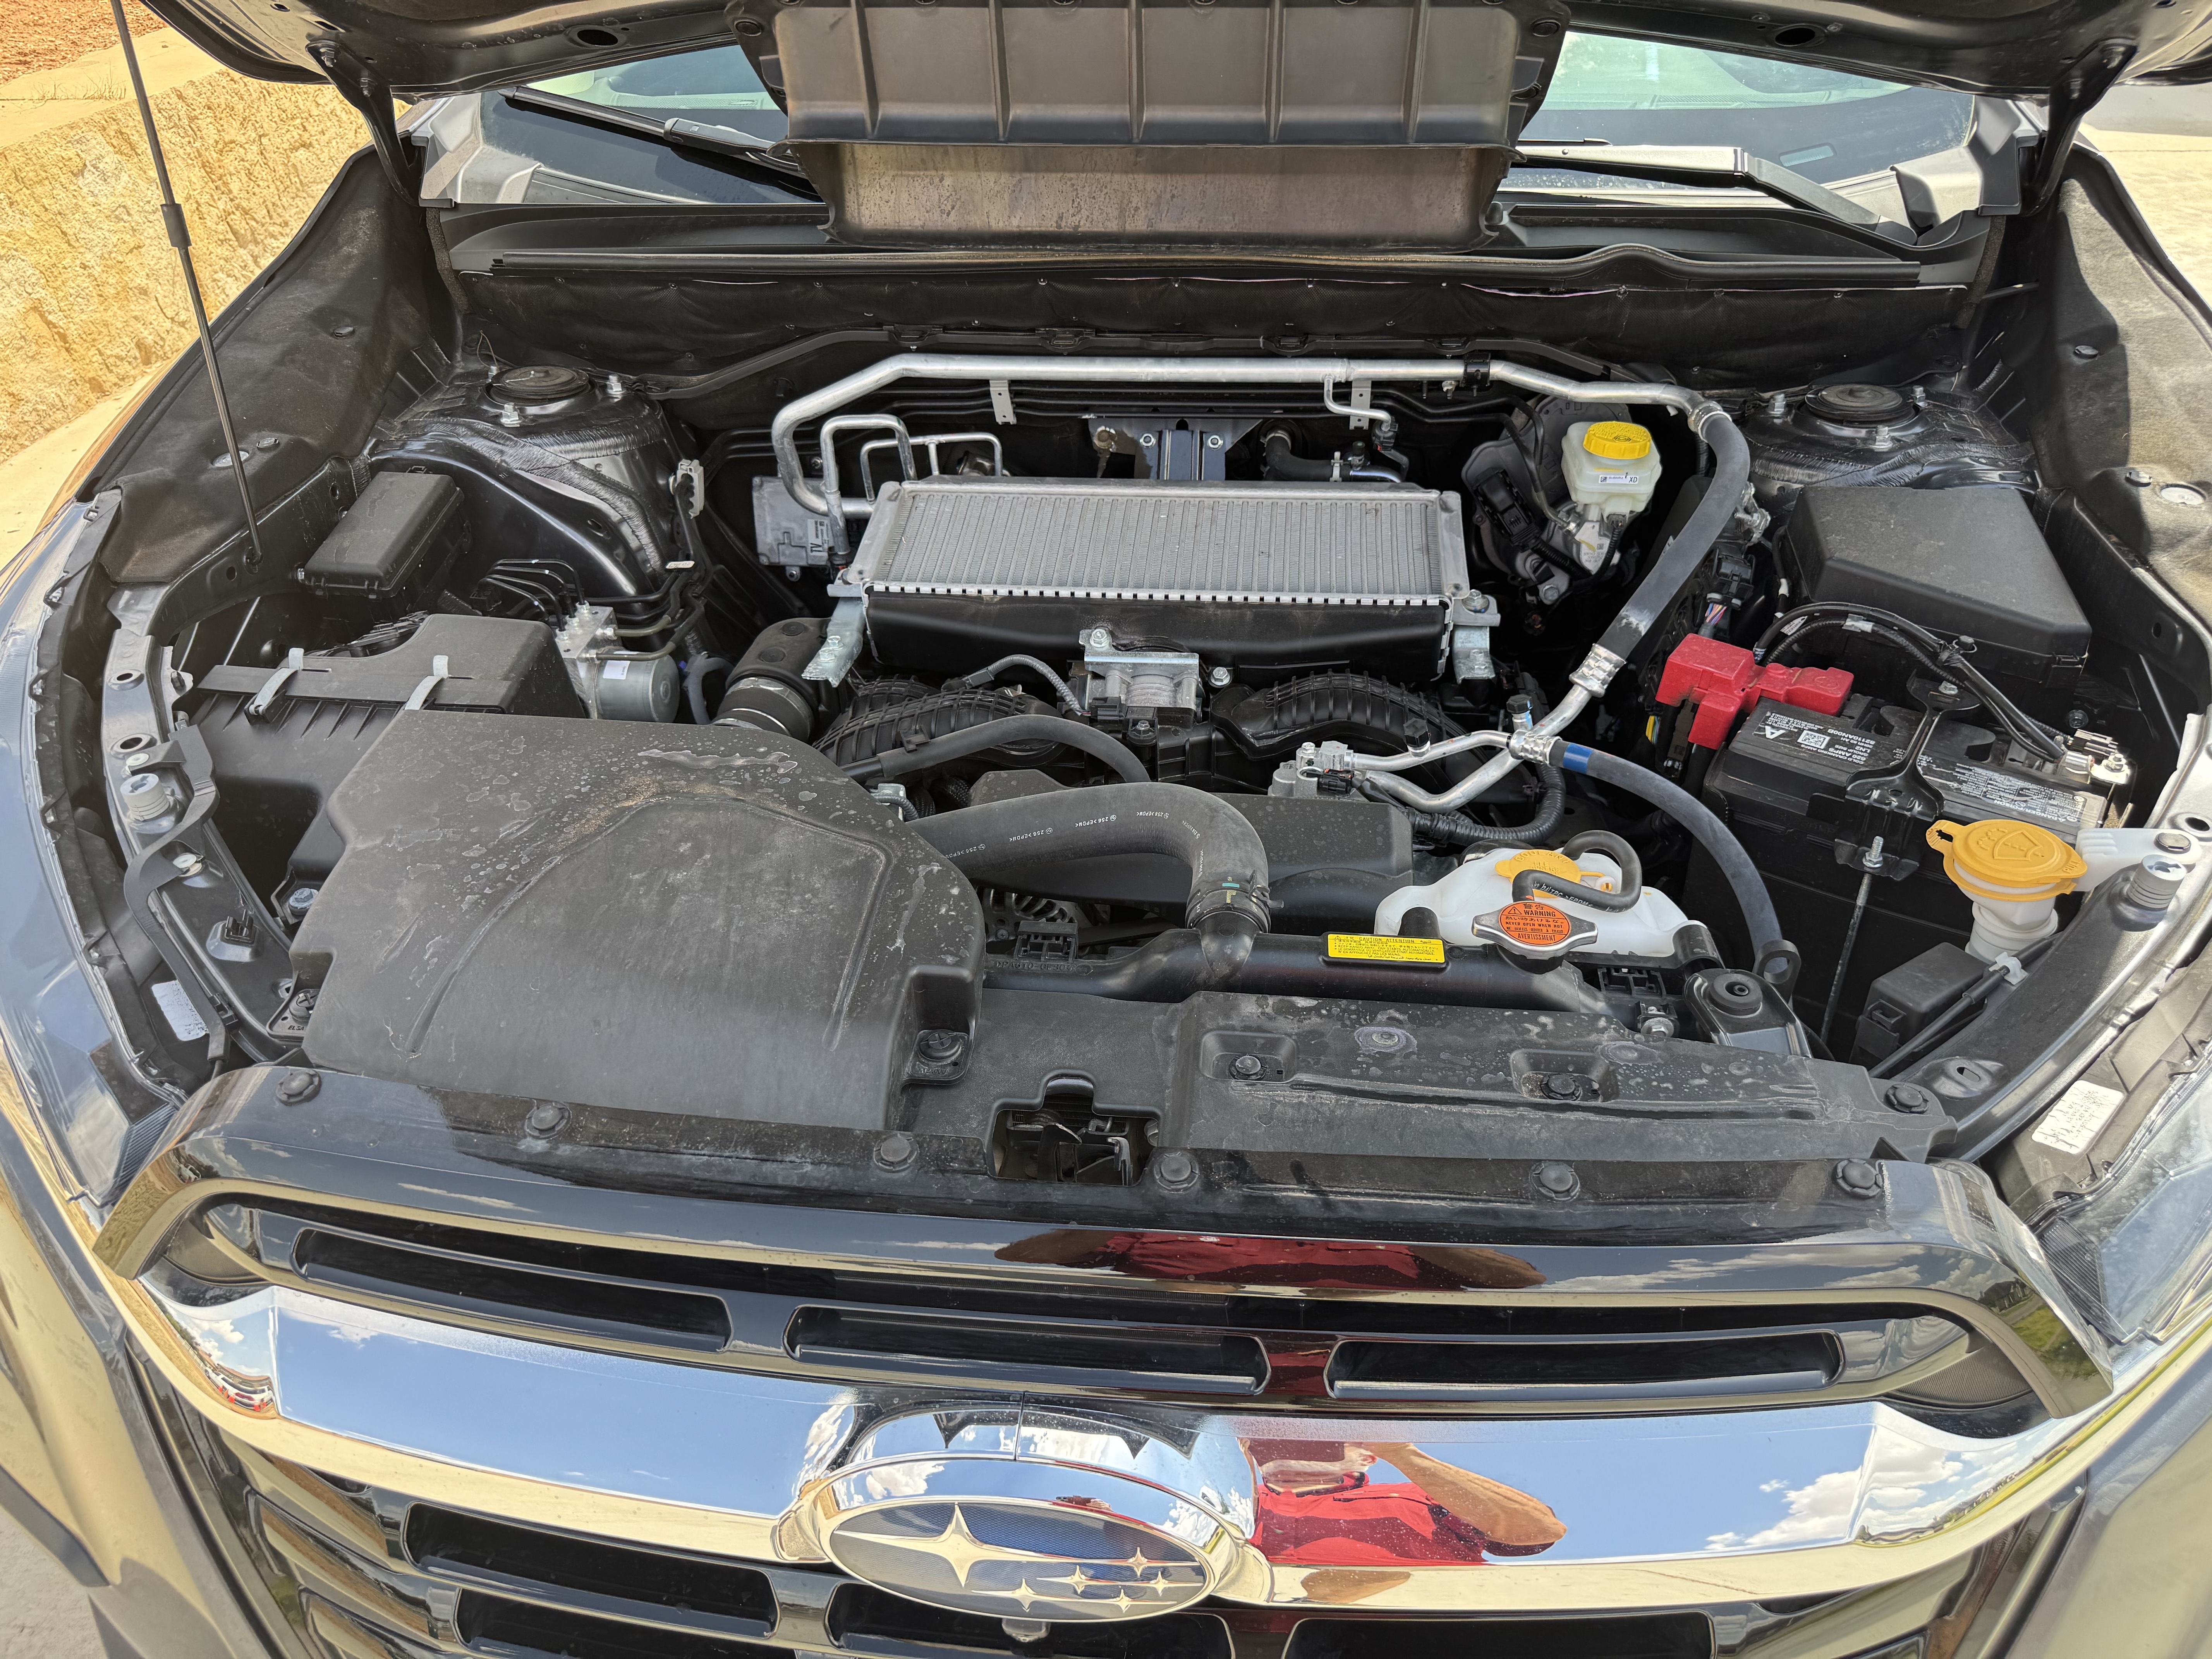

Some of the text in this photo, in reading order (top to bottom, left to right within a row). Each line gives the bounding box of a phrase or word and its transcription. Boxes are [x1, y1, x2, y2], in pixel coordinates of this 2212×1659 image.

[1818, 749, 1847, 759] CRANKING
[1829, 748, 1851, 757] AMPS
[1994, 800, 2057, 821] DANGER/POISON
[1515, 850, 1570, 864] COOLANT
[2062, 860, 2080, 874] PULL
